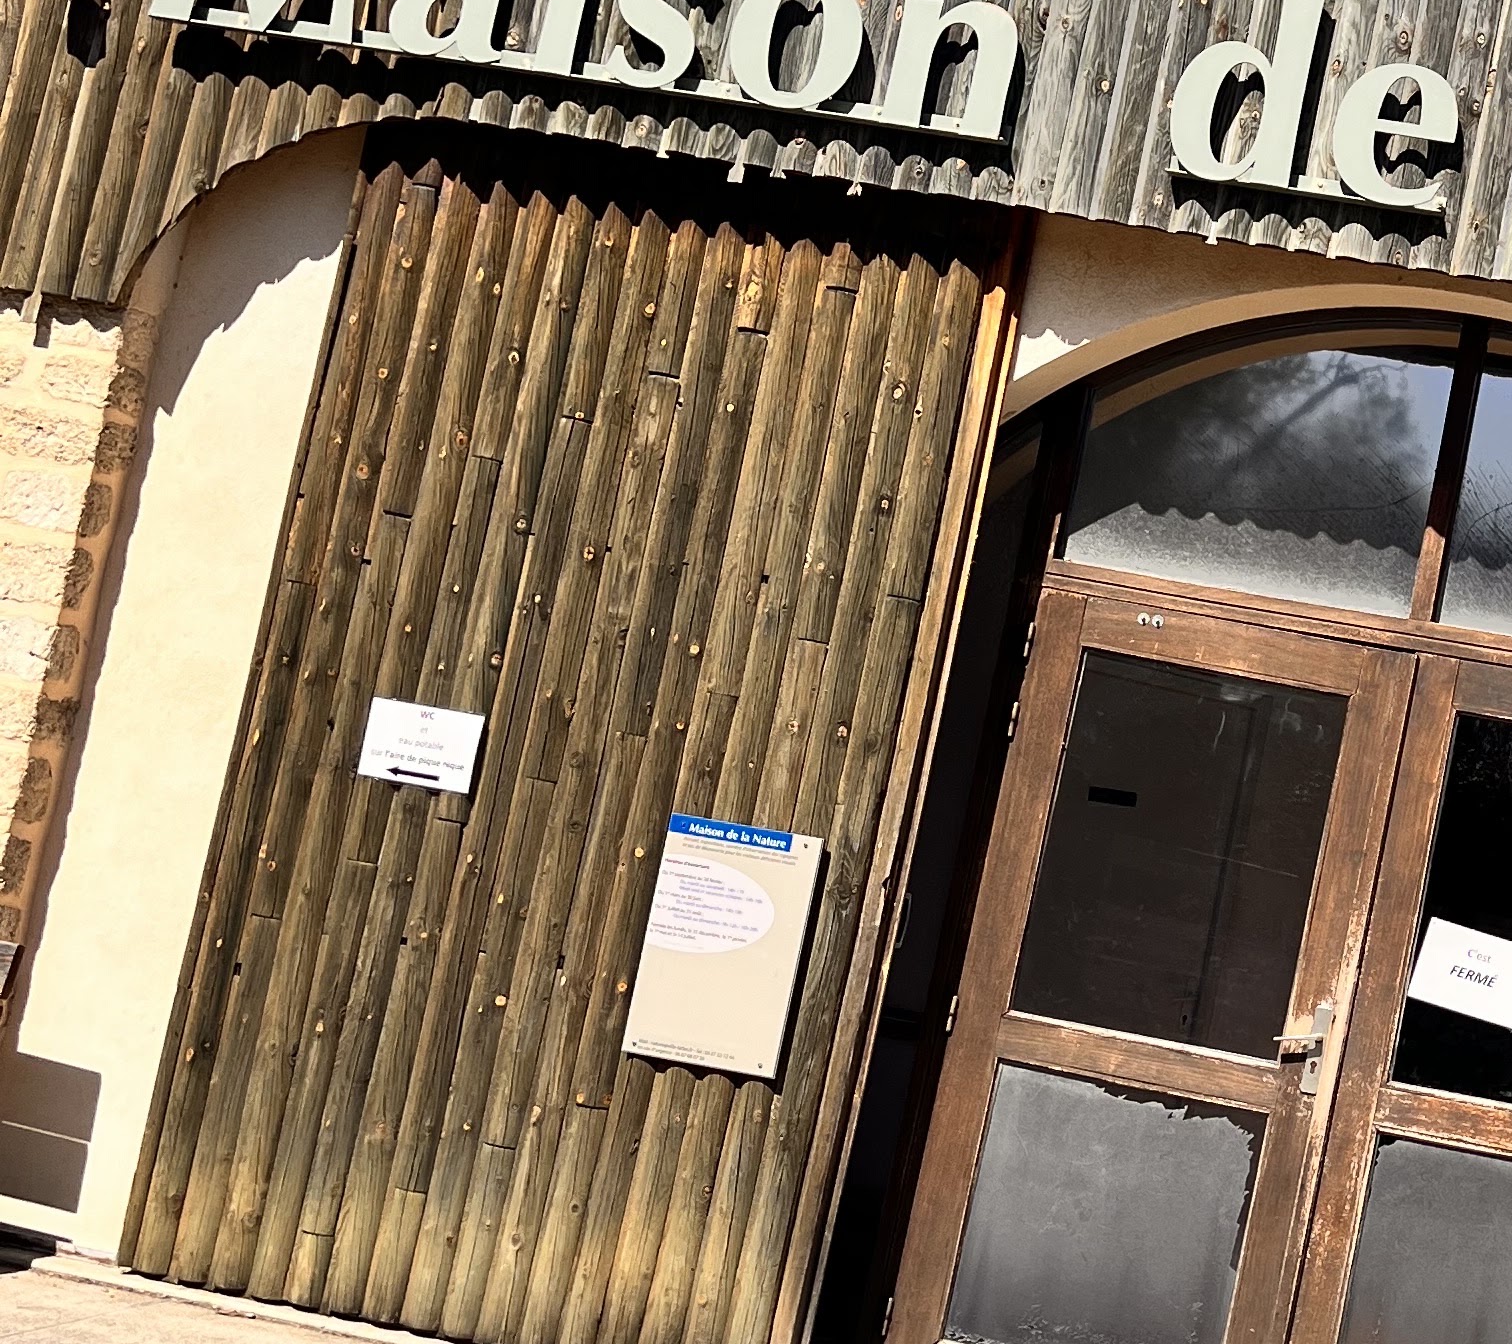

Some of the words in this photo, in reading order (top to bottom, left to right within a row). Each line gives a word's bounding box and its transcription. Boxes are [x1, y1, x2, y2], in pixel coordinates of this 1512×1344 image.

[420, 711, 435, 720] WC
[689, 822, 725, 839] Maison
[726, 829, 739, 840] de
[740, 831, 750, 843] la
[752, 834, 787, 849] Nature
[1467, 949, 1492, 964] C'est
[1450, 965, 1498, 988] FERMÉ
